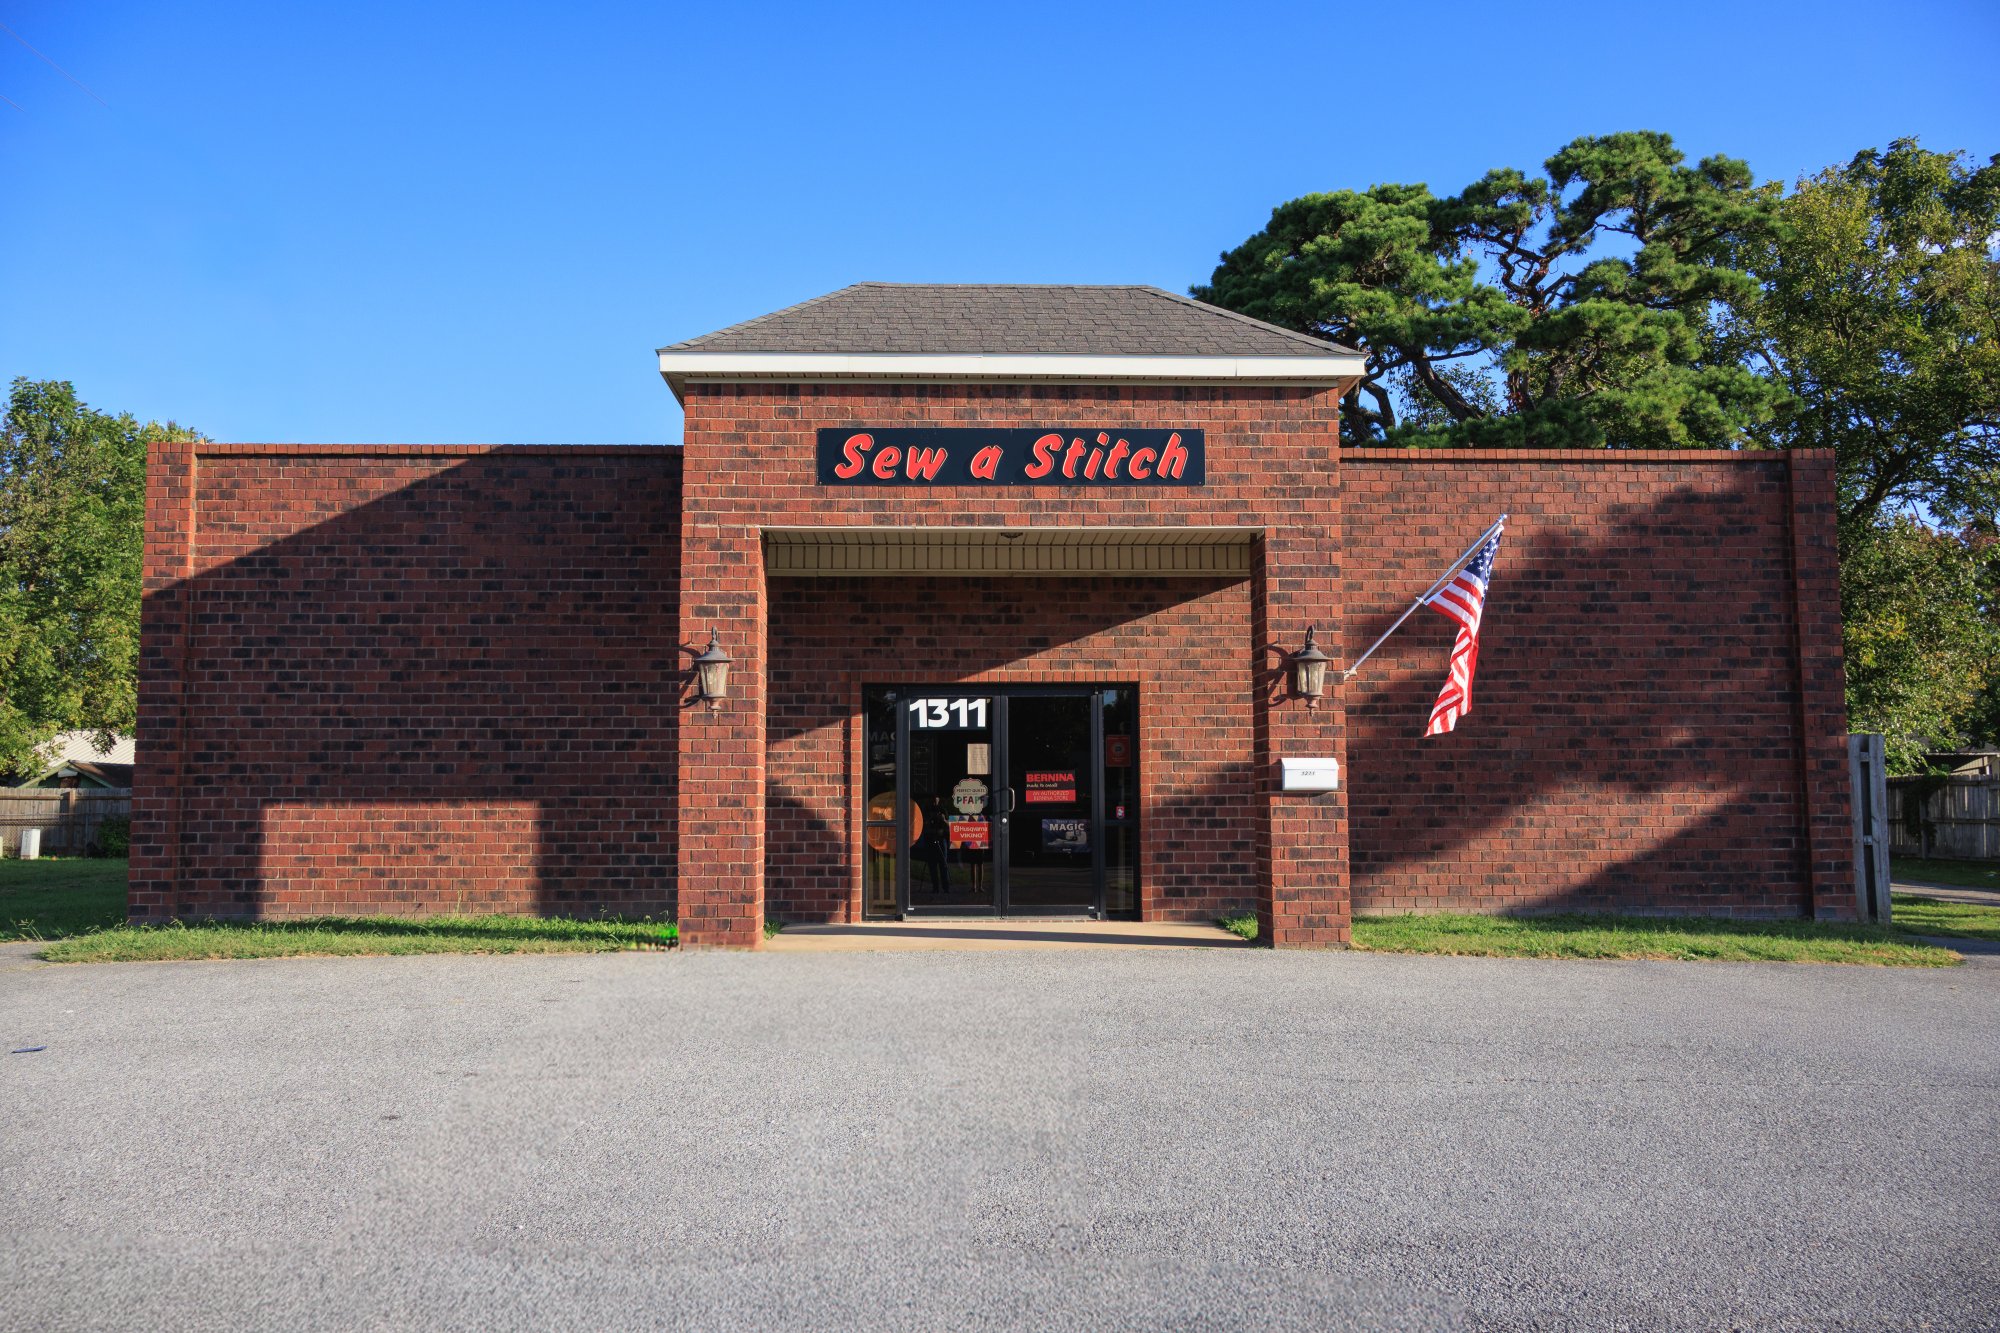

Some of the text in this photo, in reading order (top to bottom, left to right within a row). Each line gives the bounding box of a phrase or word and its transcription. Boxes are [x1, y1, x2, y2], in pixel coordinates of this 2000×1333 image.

[835, 431, 1189, 480] Sew a Stitch
[909, 698, 987, 728] 1311
[1026, 773, 1075, 782] BERNINA
[1049, 823, 1085, 831] MAGIC
